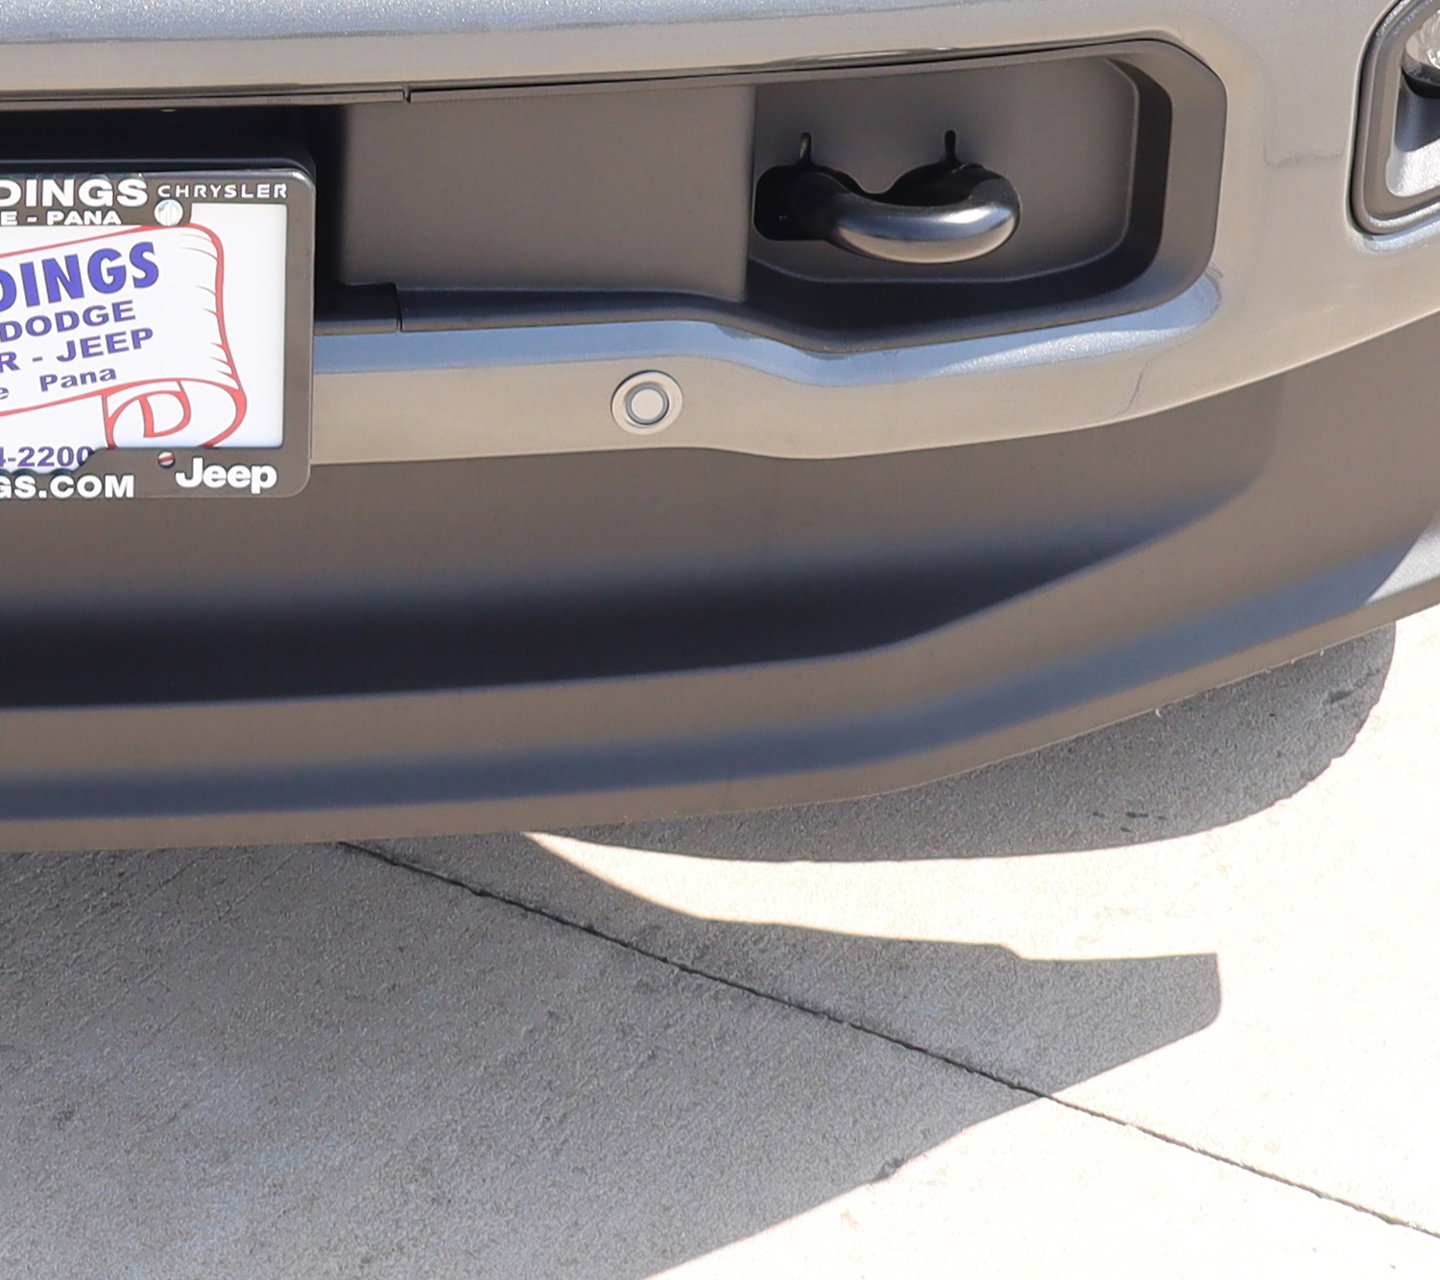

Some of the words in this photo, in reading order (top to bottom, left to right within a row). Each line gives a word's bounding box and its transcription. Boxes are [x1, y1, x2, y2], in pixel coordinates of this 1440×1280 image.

[157, 183, 288, 199] CHRYSLER
[46, 210, 122, 226] PANA
[56, 327, 154, 363] JEEP
[39, 368, 117, 392] Pana
[174, 457, 277, 498] Jeep
